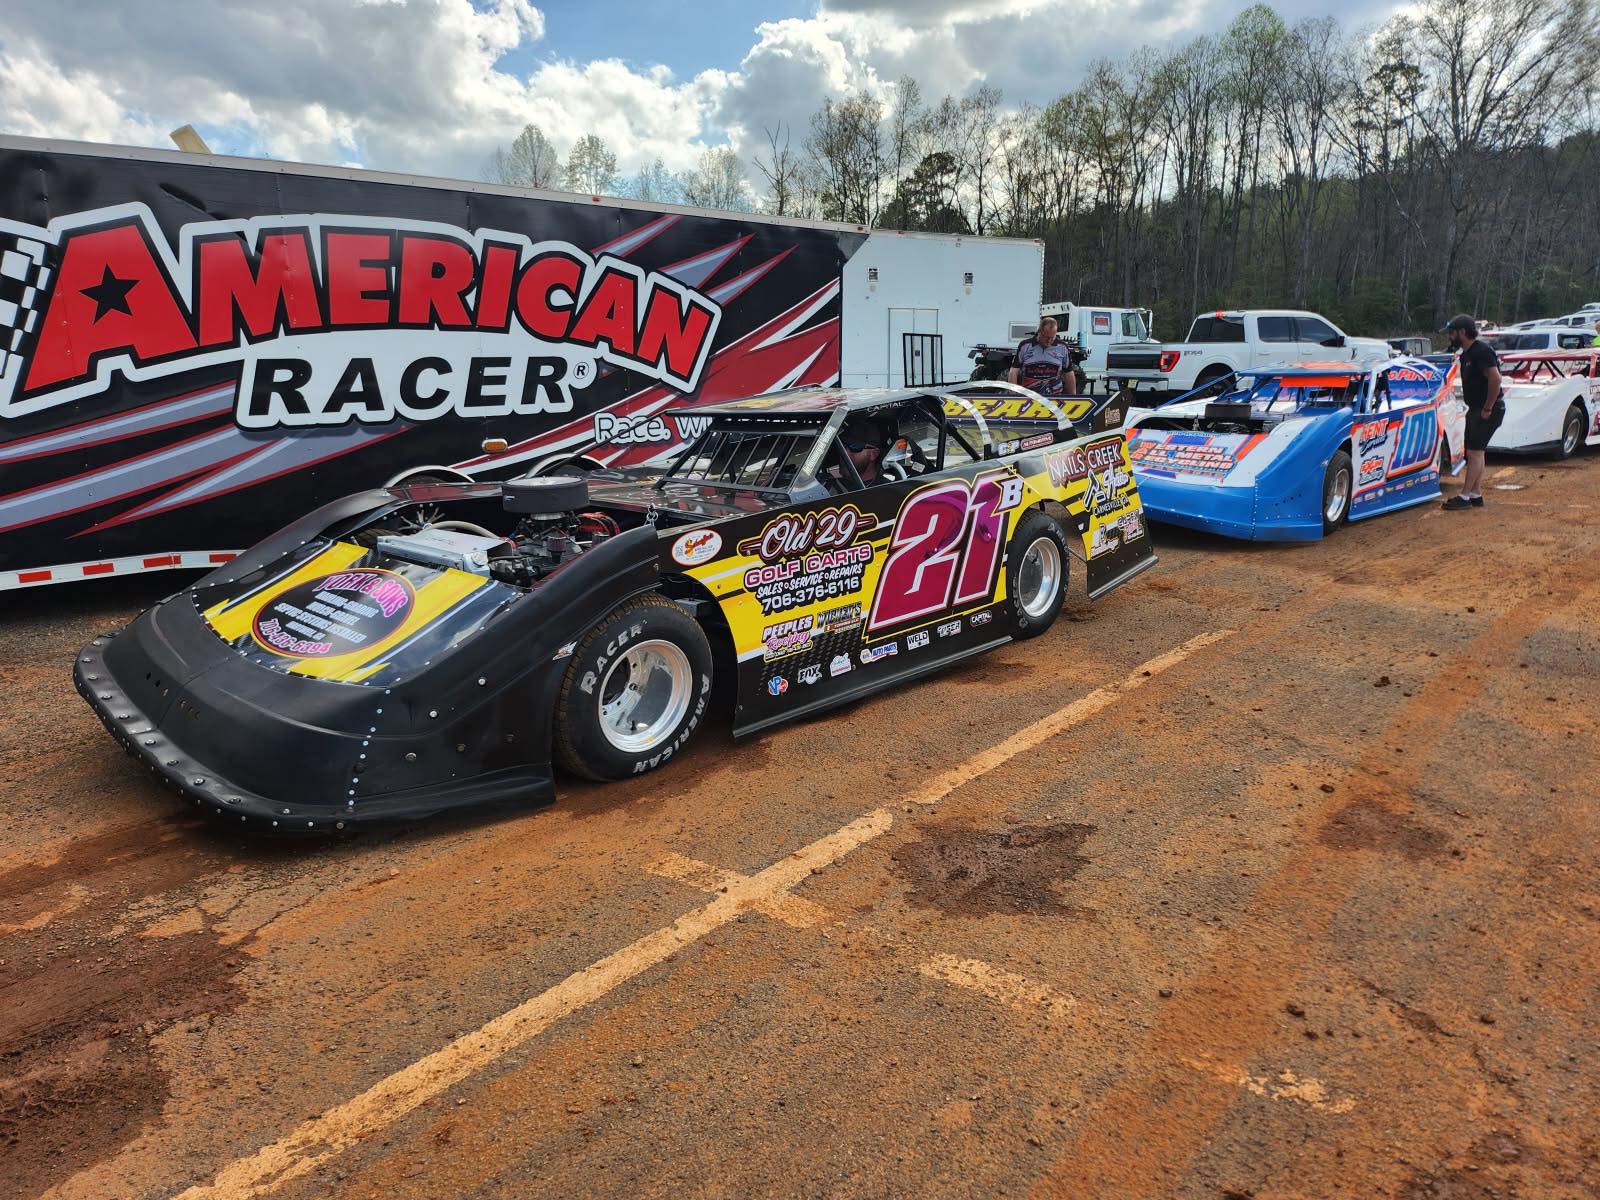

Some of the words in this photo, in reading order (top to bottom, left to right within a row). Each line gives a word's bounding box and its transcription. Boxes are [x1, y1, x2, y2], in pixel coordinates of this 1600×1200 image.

[23, 224, 713, 392] AMERICAN
[942, 399, 1093, 420] BEARD
[1140, 441, 1224, 455] WESTERN
[1173, 451, 1233, 462] METAL
[1389, 408, 1437, 471] 100
[1048, 453, 1086, 481] NAILS
[1087, 442, 1121, 470] CREEK
[1129, 452, 1234, 470] RECYCLING
[761, 519, 813, 558] Old
[815, 510, 857, 545] 29
[313, 573, 377, 592] YORK
[744, 559, 800, 588] GOLF
[805, 543, 872, 573] CARTS
[757, 582, 783, 599] SALES
[788, 571, 825, 591] SERVICE
[828, 563, 863, 581] REPAIRS
[361, 577, 383, 594] &
[371, 579, 408, 617] SONS
[761, 576, 860, 612] 706-376-6116
[762, 615, 814, 641] PEEPLES
[971, 612, 992, 623] CAPITAL
[907, 631, 928, 645] WELD
[579, 623, 643, 695] RACER
[632, 673, 710, 774] AMERICAN
